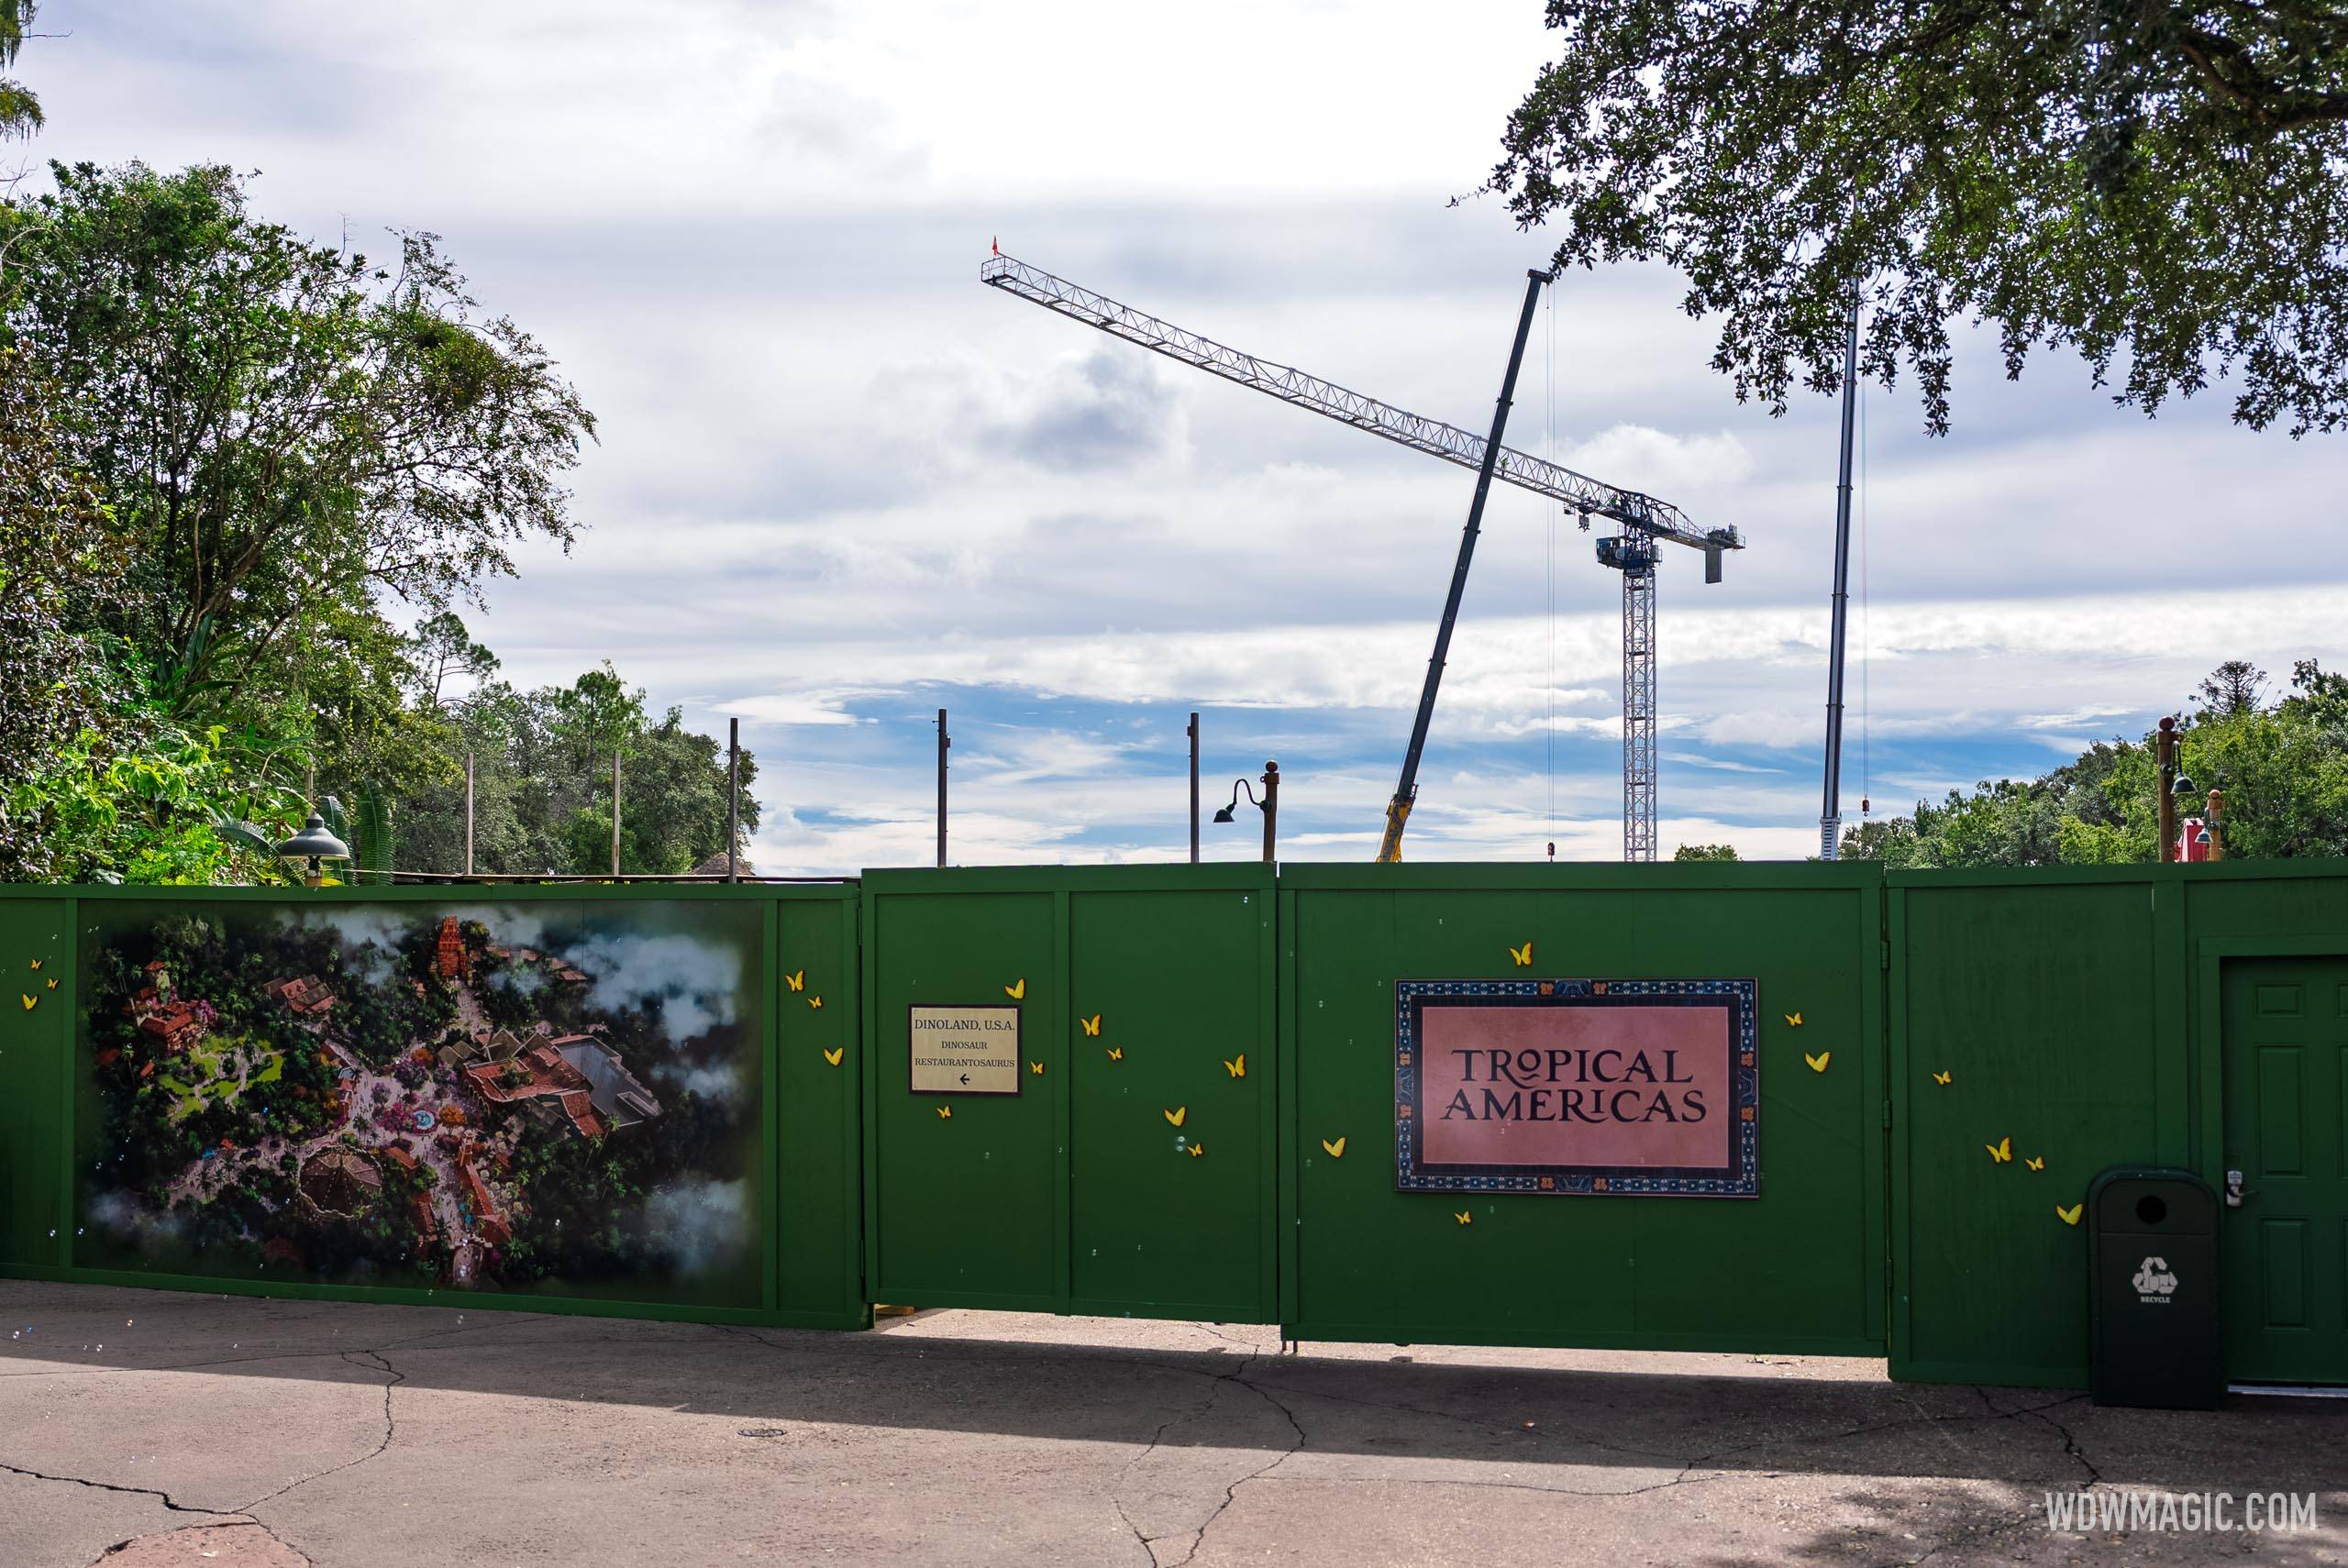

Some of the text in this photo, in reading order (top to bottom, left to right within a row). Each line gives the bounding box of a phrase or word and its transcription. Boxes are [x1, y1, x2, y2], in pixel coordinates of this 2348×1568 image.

[914, 1019, 1015, 1031] DINOLAND, U.S.A.
[941, 1041, 988, 1050] DINOSAUR
[914, 1057, 1015, 1067] RESTAURANTOSAURUS
[1451, 1048, 1693, 1089] TROPICAL
[1439, 1088, 1707, 1124] AMERICAS
[2140, 1296, 2171, 1304] RECYCLE
